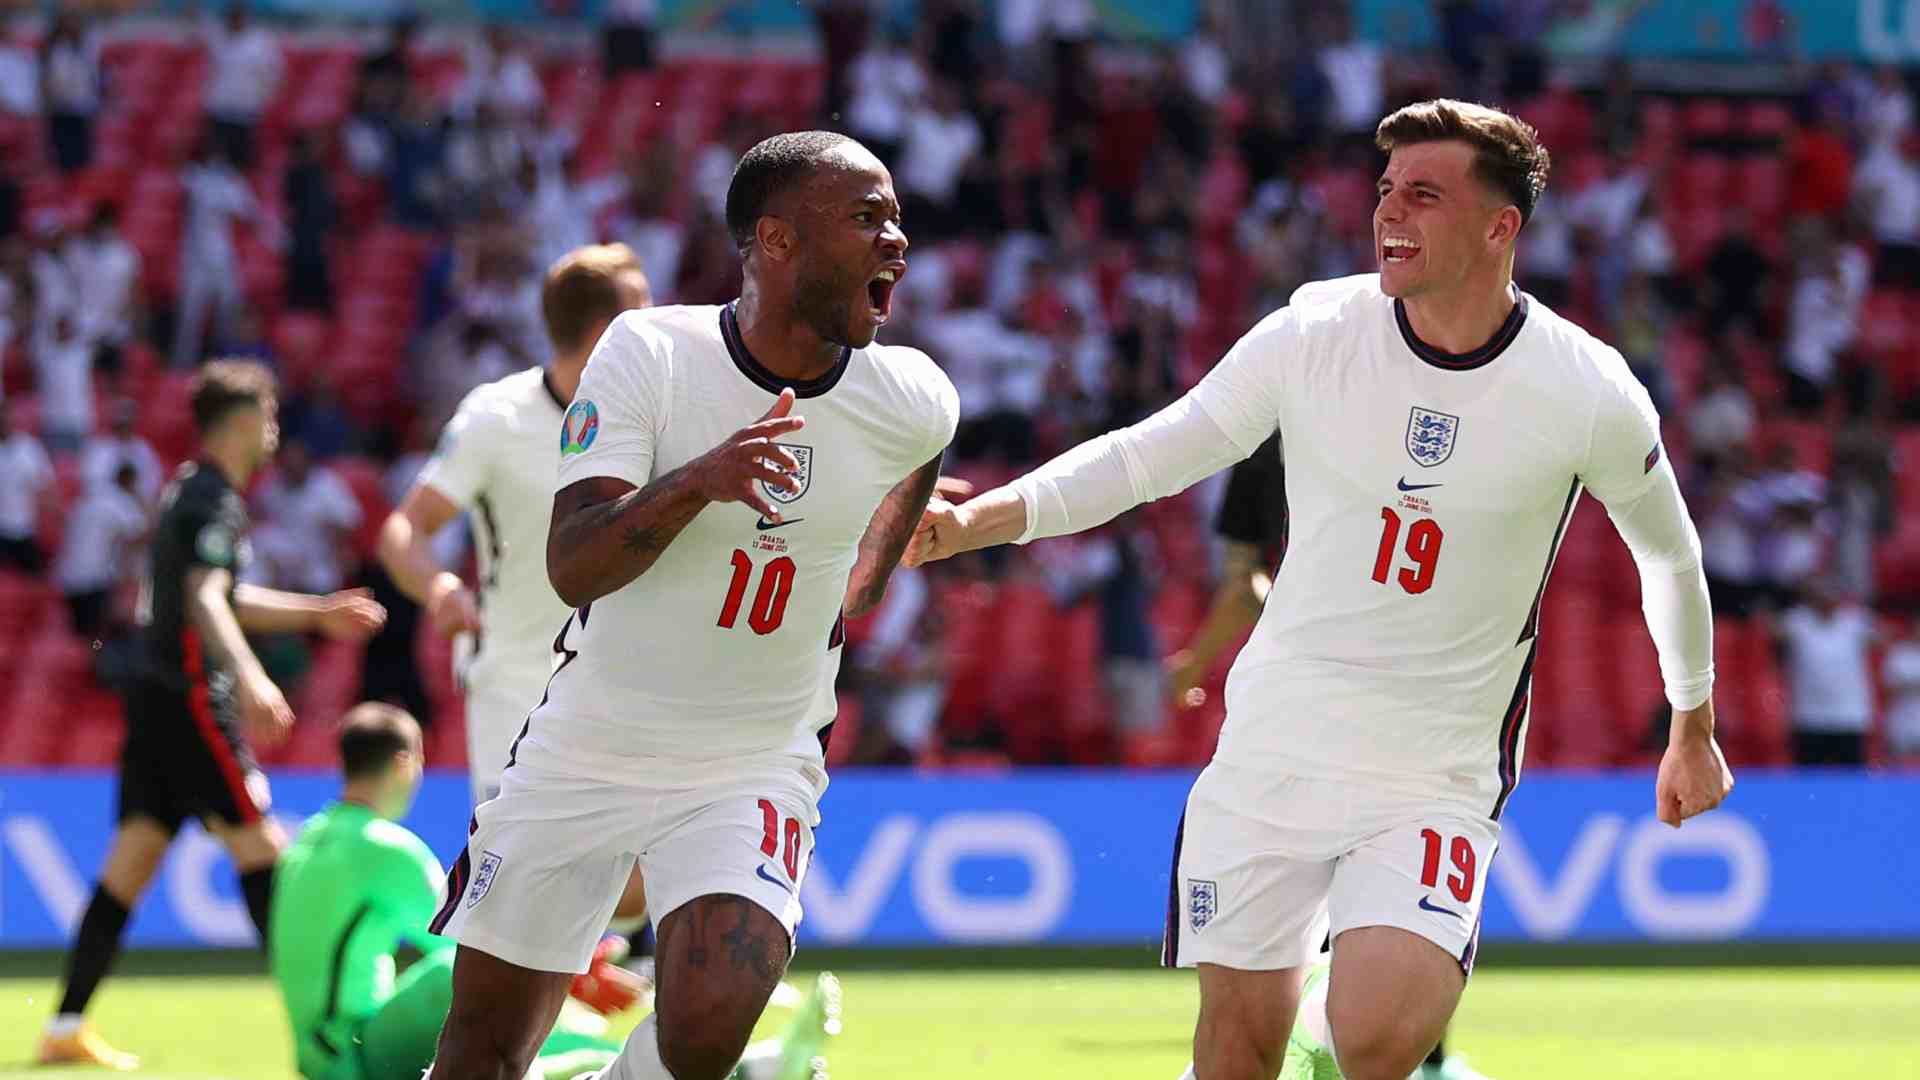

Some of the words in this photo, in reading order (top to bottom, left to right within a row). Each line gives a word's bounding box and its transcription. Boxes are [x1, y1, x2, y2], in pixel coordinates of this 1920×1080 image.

[717, 548, 797, 635] 10
[1371, 506, 1444, 594] 19
[757, 799, 801, 884] 10
[1420, 828, 1476, 903] 19
